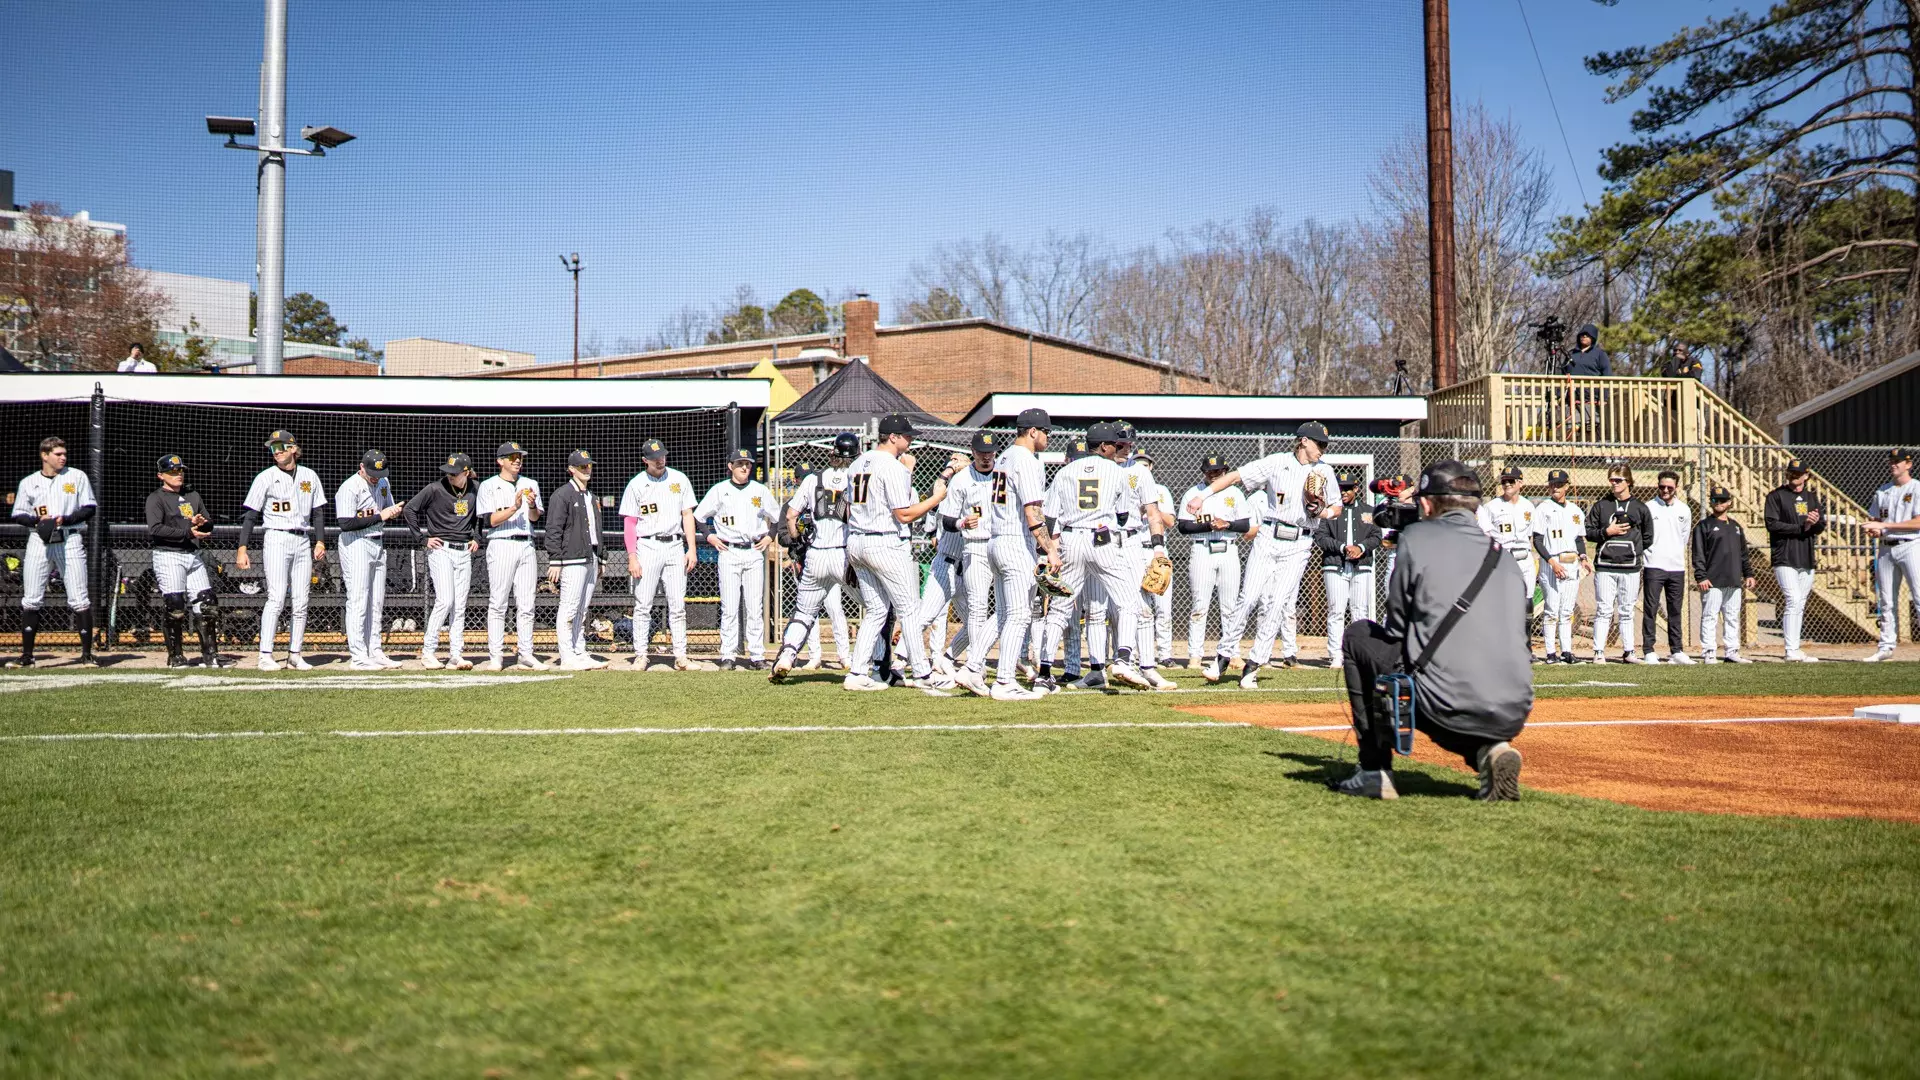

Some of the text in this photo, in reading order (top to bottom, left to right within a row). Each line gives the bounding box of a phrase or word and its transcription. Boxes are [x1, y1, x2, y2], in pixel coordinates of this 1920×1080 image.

[853, 473, 872, 504] 17
[1078, 478, 1100, 511] 5
[1276, 493, 1285, 505] 7
[34, 505, 47, 516] 16
[272, 501, 291, 512] 30
[640, 502, 658, 514] 39
[722, 516, 735, 526] 41
[1499, 523, 1512, 533] 13
[1552, 529, 1563, 539] 11
